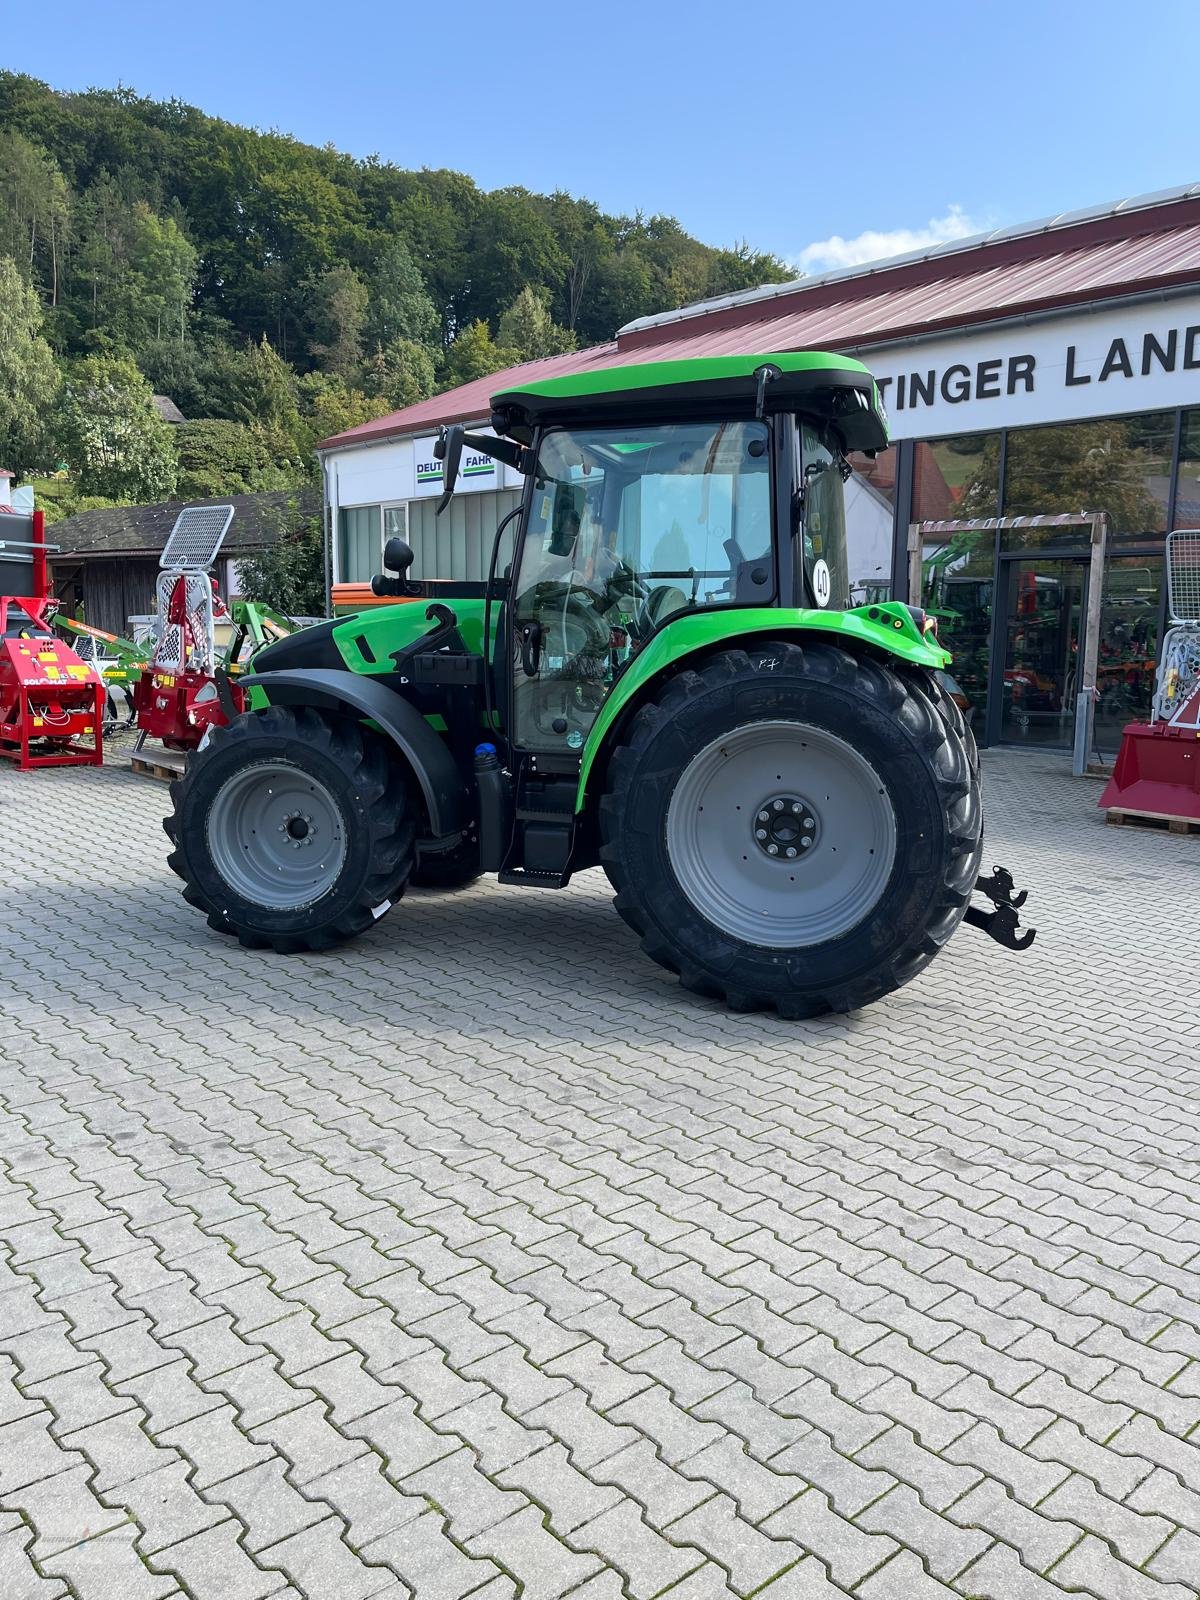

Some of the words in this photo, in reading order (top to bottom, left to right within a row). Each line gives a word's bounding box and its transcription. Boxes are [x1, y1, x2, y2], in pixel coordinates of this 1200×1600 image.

[417, 461, 444, 473] DEUT
[466, 455, 492, 467] FAHR
[817, 568, 828, 597] 40
